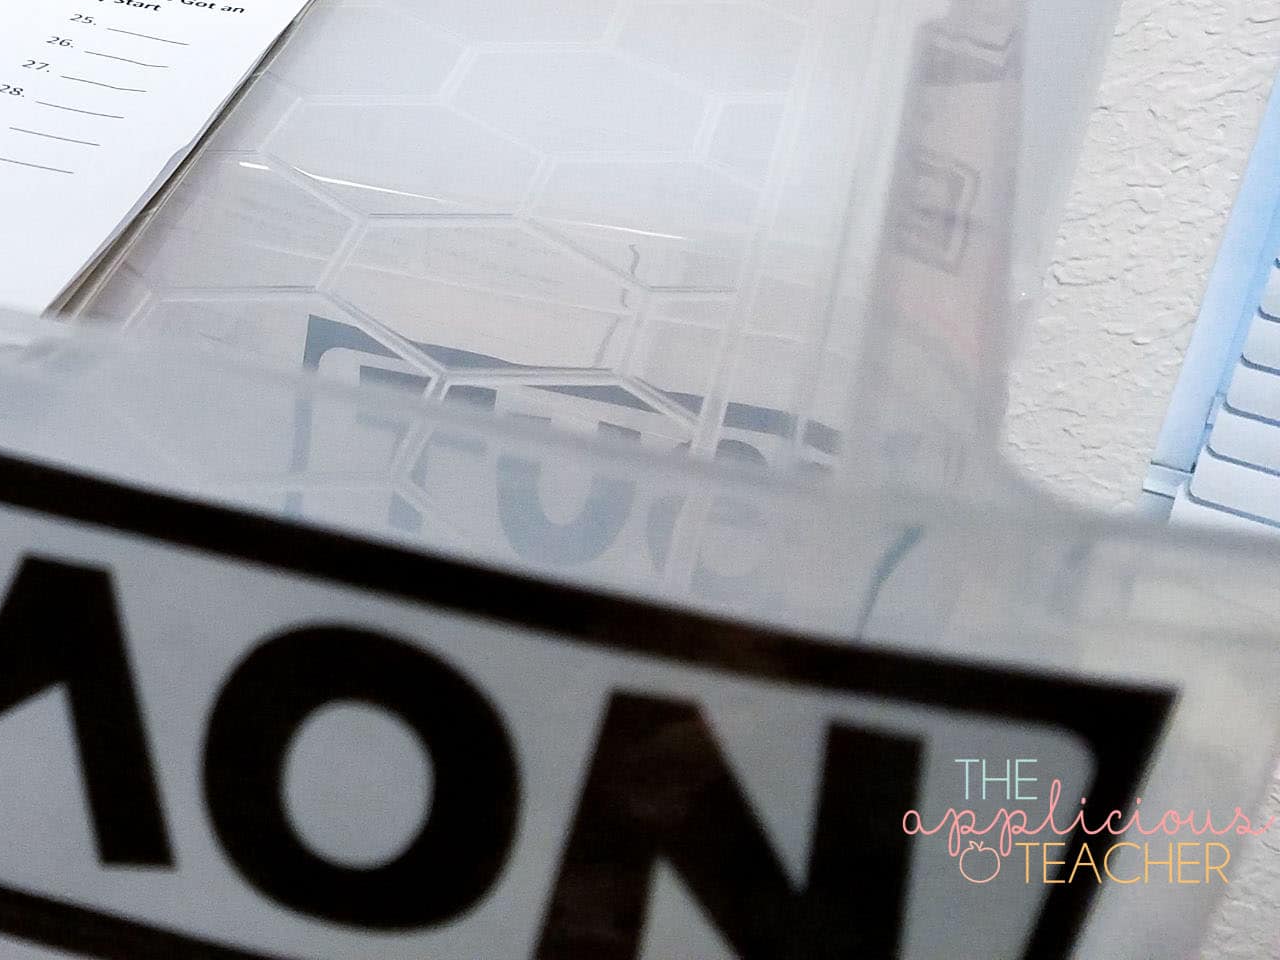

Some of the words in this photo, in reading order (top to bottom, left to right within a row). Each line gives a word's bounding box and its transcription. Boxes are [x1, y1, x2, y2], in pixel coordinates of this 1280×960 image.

[220, 4, 246, 14] an
[69, 13, 97, 26] 25.
[46, 35, 74, 48] 26.
[21, 59, 50, 73] 27.
